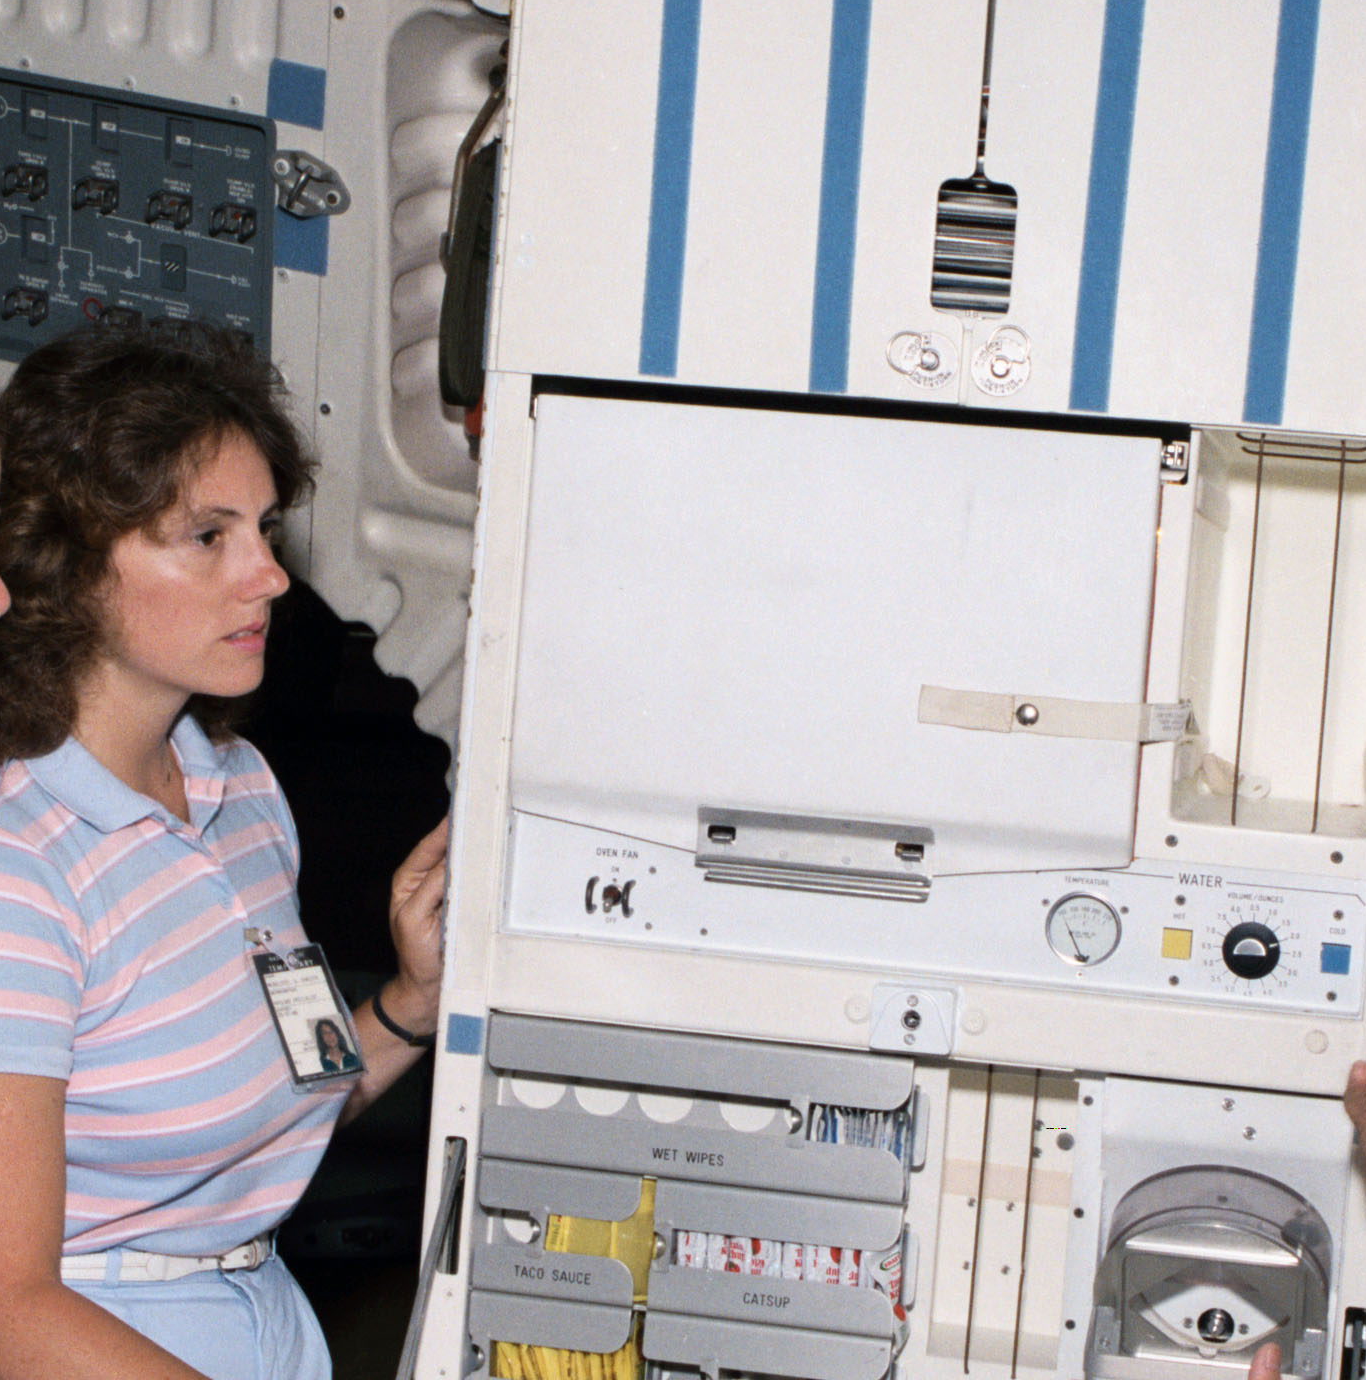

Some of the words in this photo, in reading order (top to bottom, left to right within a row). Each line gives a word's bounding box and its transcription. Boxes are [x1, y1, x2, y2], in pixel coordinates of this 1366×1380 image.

[597, 848, 617, 856] OVEN
[622, 850, 638, 858] FAN
[1065, 876, 1110, 887] TEMPERATURE
[1178, 873, 1223, 888] WATER
[1330, 927, 1346, 935] COLD
[653, 1148, 677, 1162] WET
[686, 1152, 723, 1166] WIPES
[515, 1265, 544, 1279] TACO
[552, 1270, 591, 1285] SAUCE
[743, 1292, 790, 1308] CATSUP
